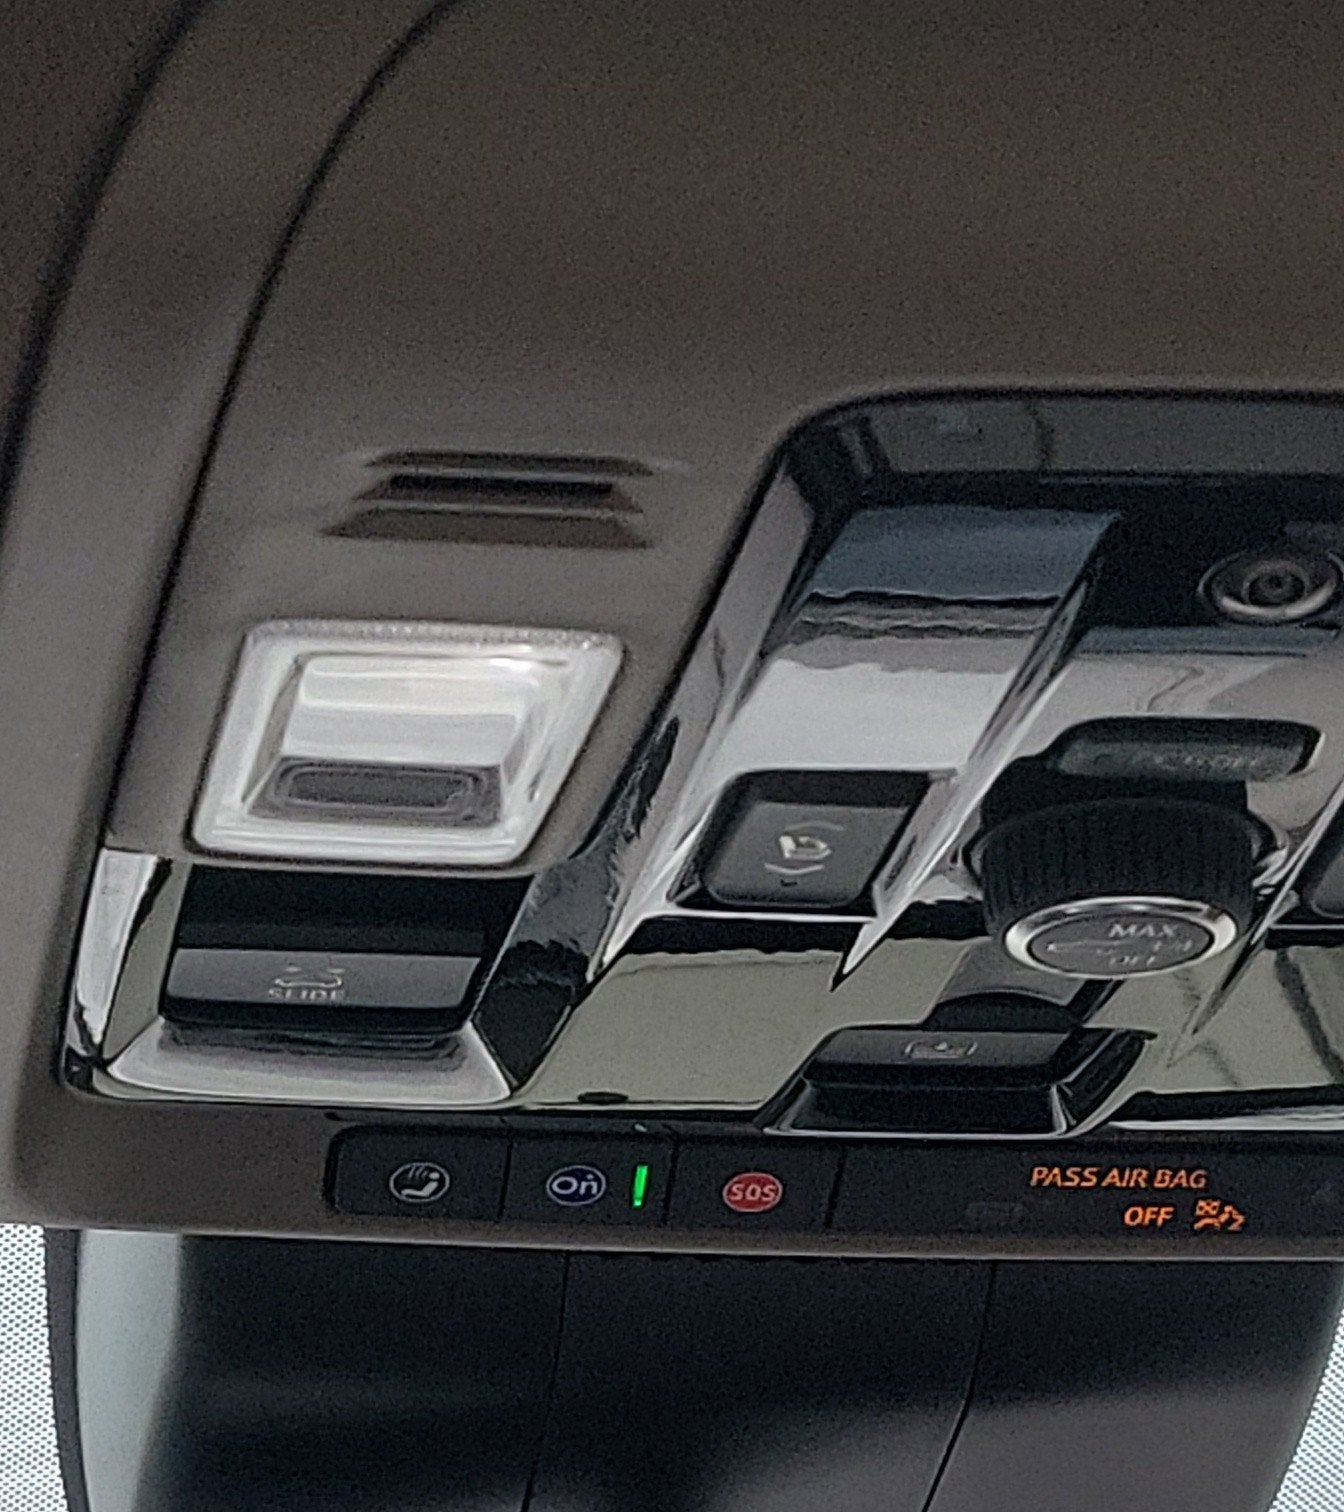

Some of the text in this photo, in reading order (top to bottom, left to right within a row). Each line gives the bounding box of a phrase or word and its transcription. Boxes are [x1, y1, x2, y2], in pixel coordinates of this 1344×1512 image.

[1107, 923, 1177, 938] MAX
[1030, 1166, 1208, 1189] PASS AIR BAG
[728, 1183, 776, 1201] SOS
[1123, 1205, 1175, 1227] OFF
